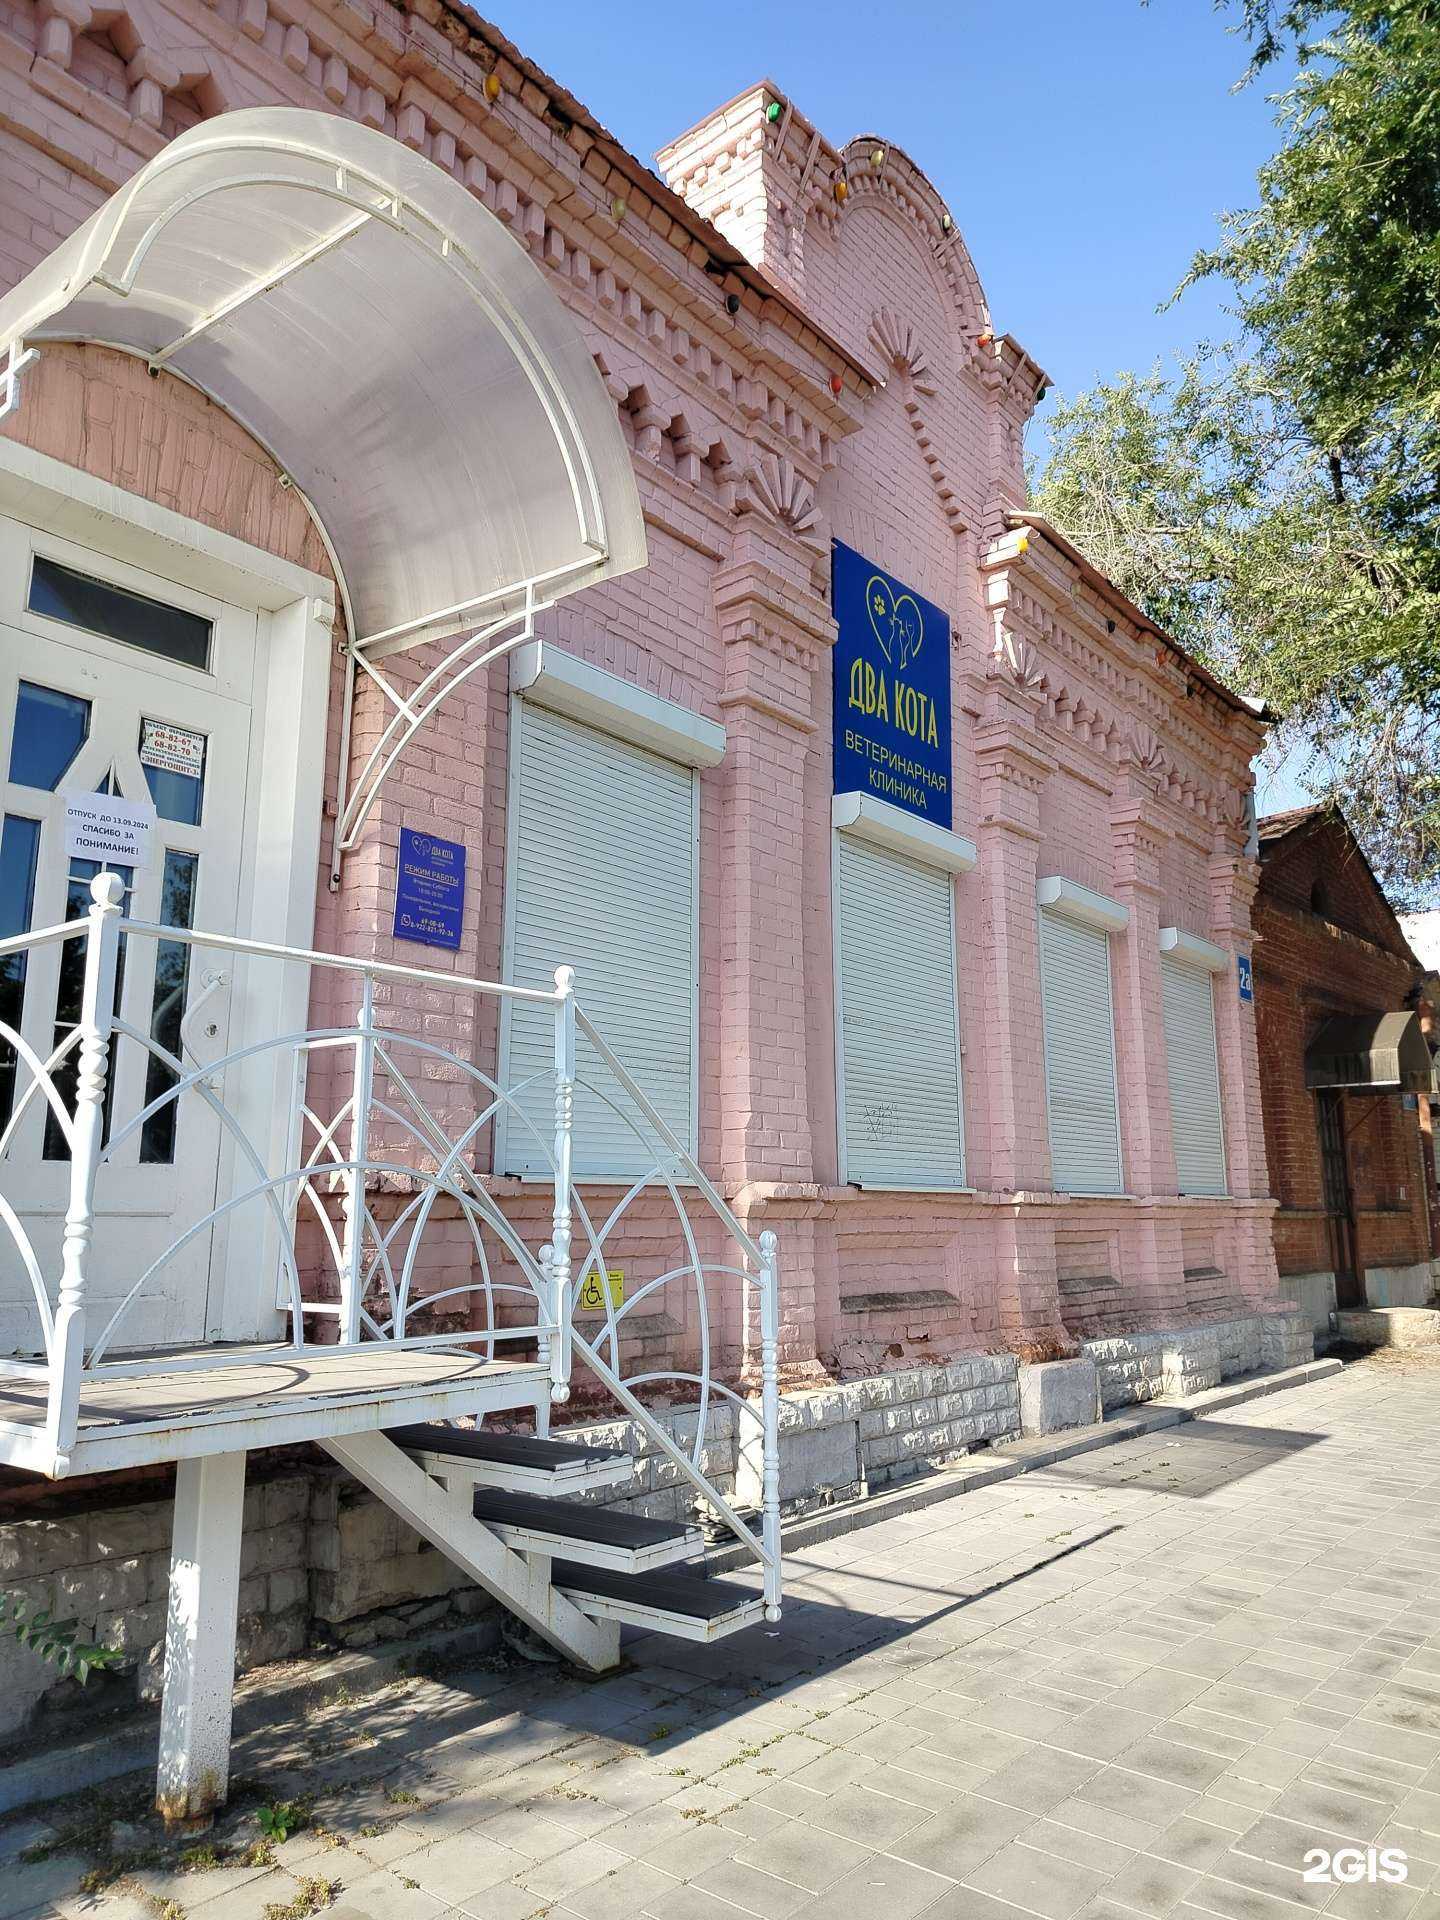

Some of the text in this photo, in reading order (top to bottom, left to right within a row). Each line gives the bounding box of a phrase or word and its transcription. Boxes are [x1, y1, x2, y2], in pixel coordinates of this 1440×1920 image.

[848, 658, 939, 748] ДВА КОТА
[154, 740, 191, 756] 68-82-70
[155, 730, 191, 747] 68-82-67
[845, 729, 948, 794] ВЕТЕРИНАРНАЯ
[869, 767, 927, 810] КЛИНИКА
[67, 808, 149, 830] ОТПУСК ДО 13.09.2024
[82, 824, 135, 840] СПАСИБО ЗА
[76, 837, 139, 856] ПОНИМАНИЕ!
[431, 846, 441, 856] ДВА
[441, 848, 454, 860] КОТА
[404, 863, 431, 877] РЕЖИМ
[431, 871, 460, 887] РАБОТЫ
